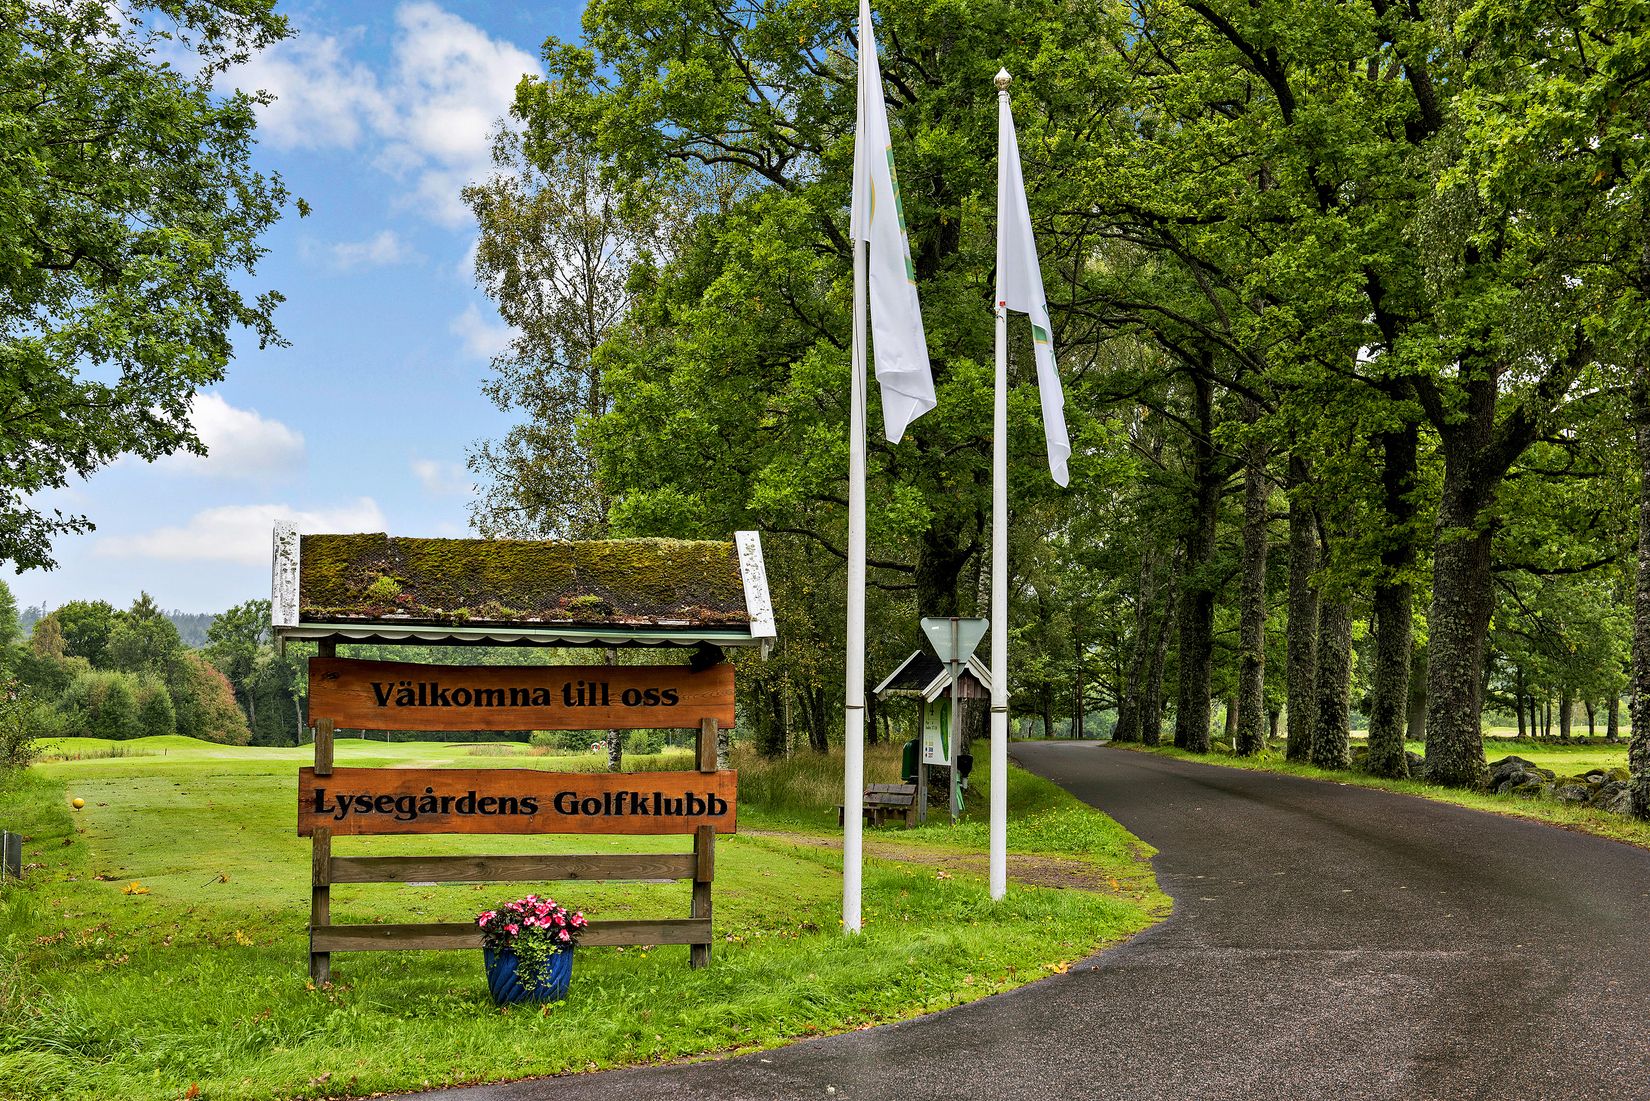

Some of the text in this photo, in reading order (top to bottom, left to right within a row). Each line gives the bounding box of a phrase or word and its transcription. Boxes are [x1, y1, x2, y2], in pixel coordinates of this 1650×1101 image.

[371, 680, 679, 707] Välkomna till oss
[314, 787, 728, 820] Lysegårdens Golfklubb
